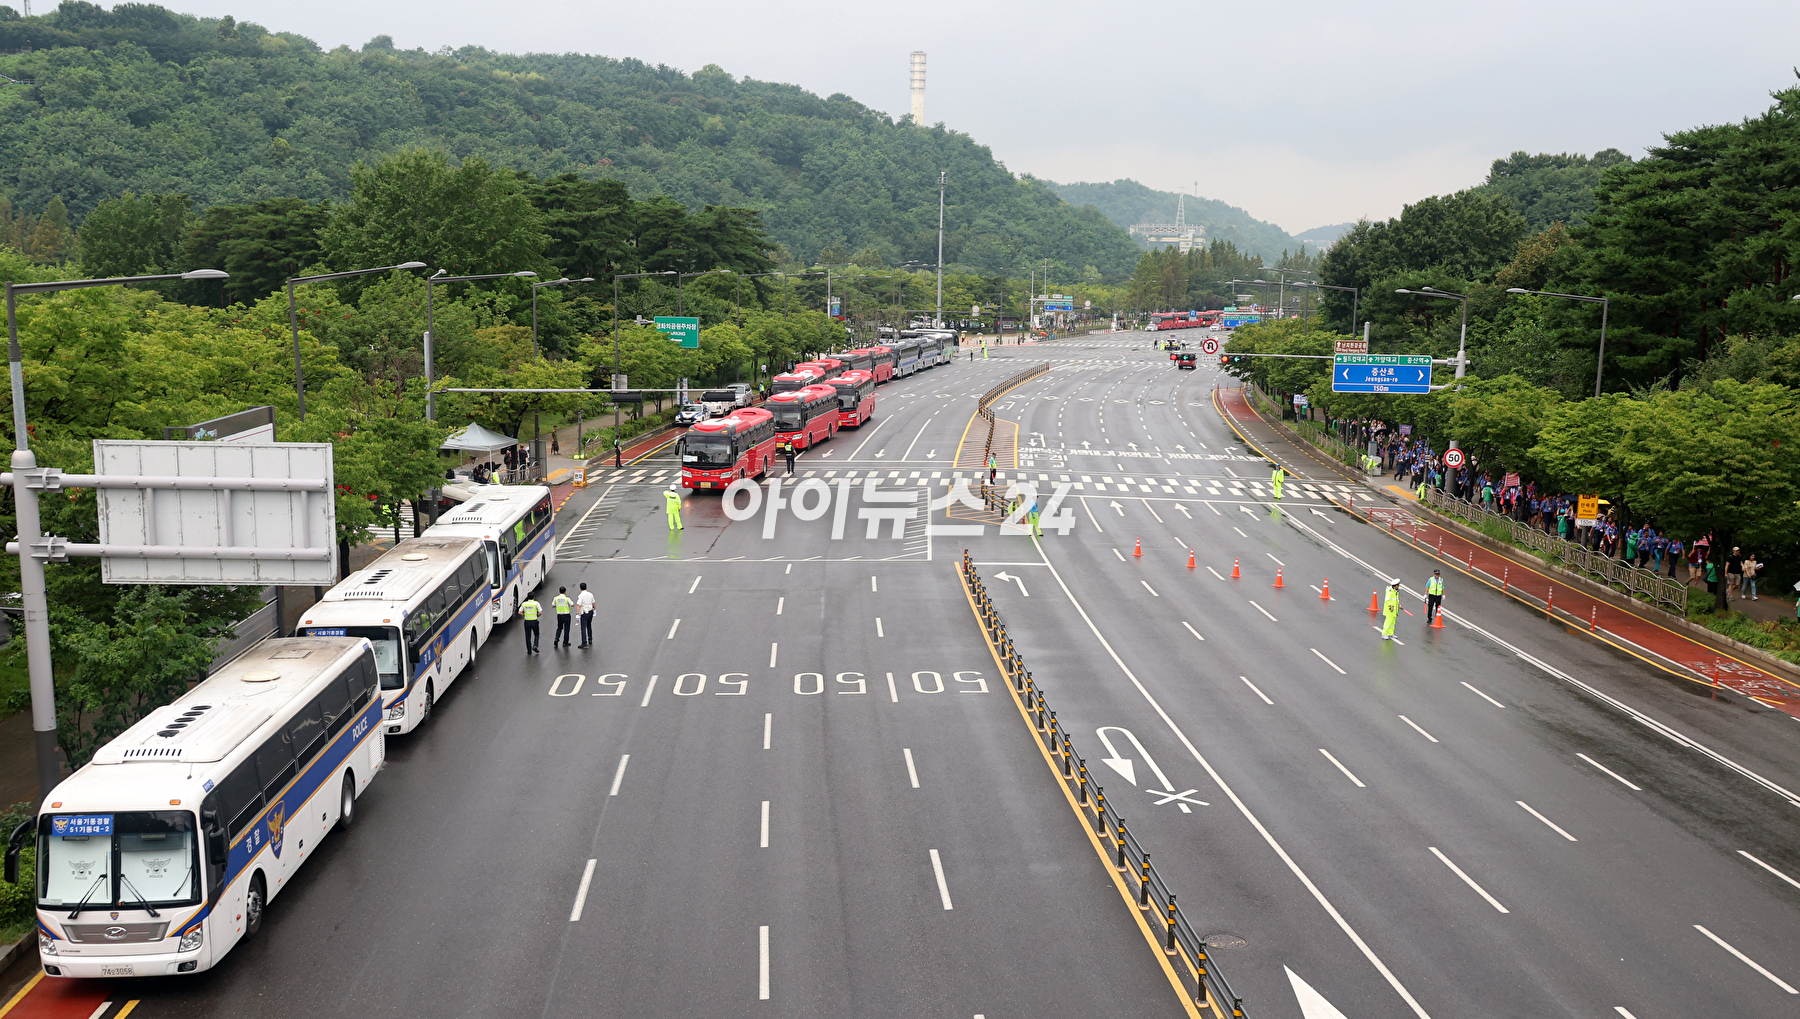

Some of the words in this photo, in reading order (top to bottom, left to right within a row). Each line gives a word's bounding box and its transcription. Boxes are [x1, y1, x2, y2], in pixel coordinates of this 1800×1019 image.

[1371, 367, 1394, 376] 증산로
[1448, 454, 1460, 462] 50
[352, 716, 368, 741] POLICE
[70, 817, 110, 826] 서울기동경찰
[70, 825, 110, 833] 51기동대-2
